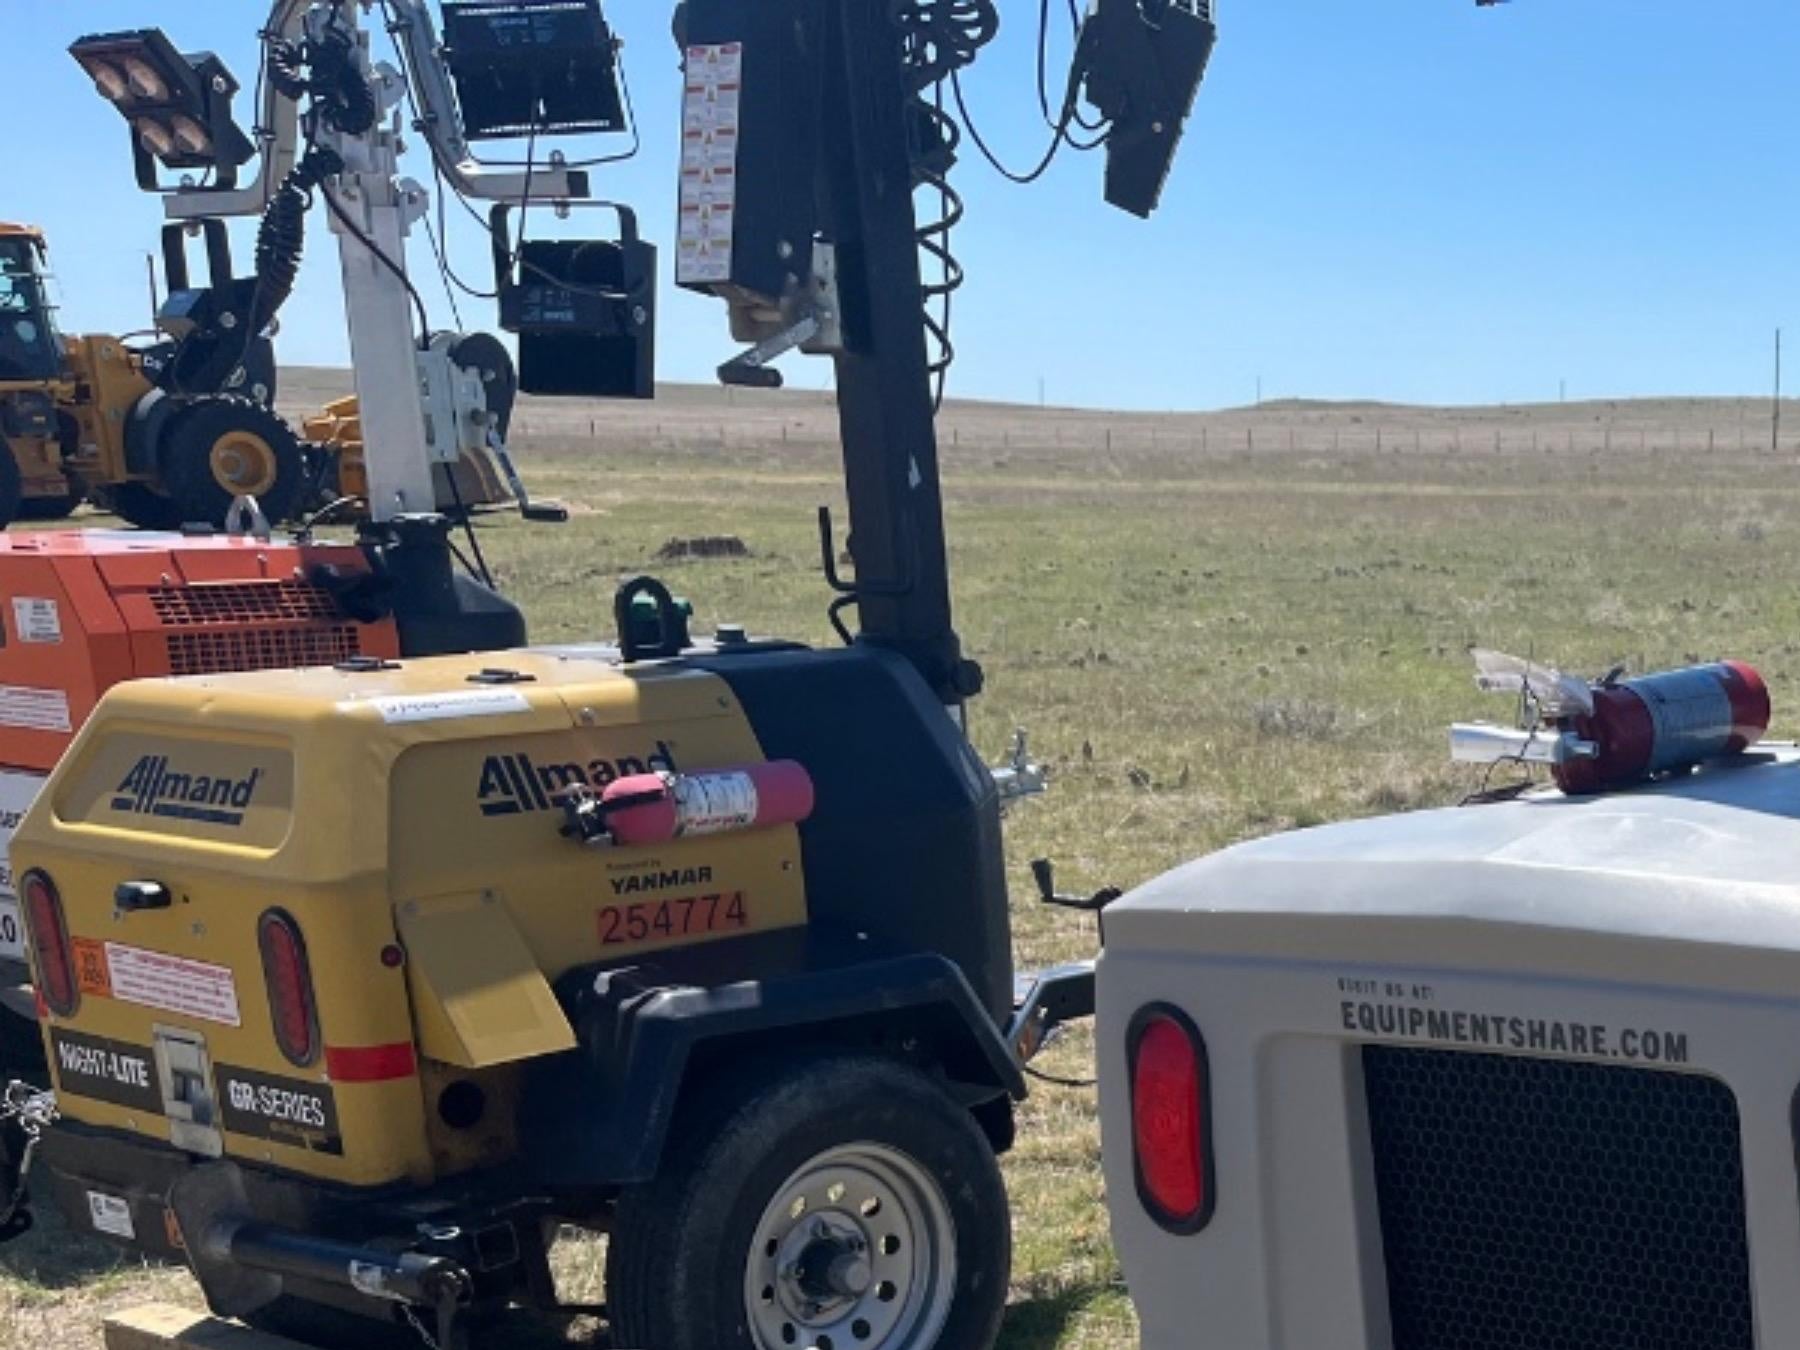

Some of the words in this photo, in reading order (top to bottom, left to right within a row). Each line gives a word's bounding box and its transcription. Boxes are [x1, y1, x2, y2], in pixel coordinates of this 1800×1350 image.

[114, 755, 260, 816] Allmand
[609, 865, 713, 895] YANMAR
[600, 890, 747, 945] 254774
[1340, 1001, 1688, 1063] EQUIPMENTSHARE.COM
[59, 1040, 150, 1088] NIGHT-LITE
[228, 1078, 326, 1127] GR-SERIES
